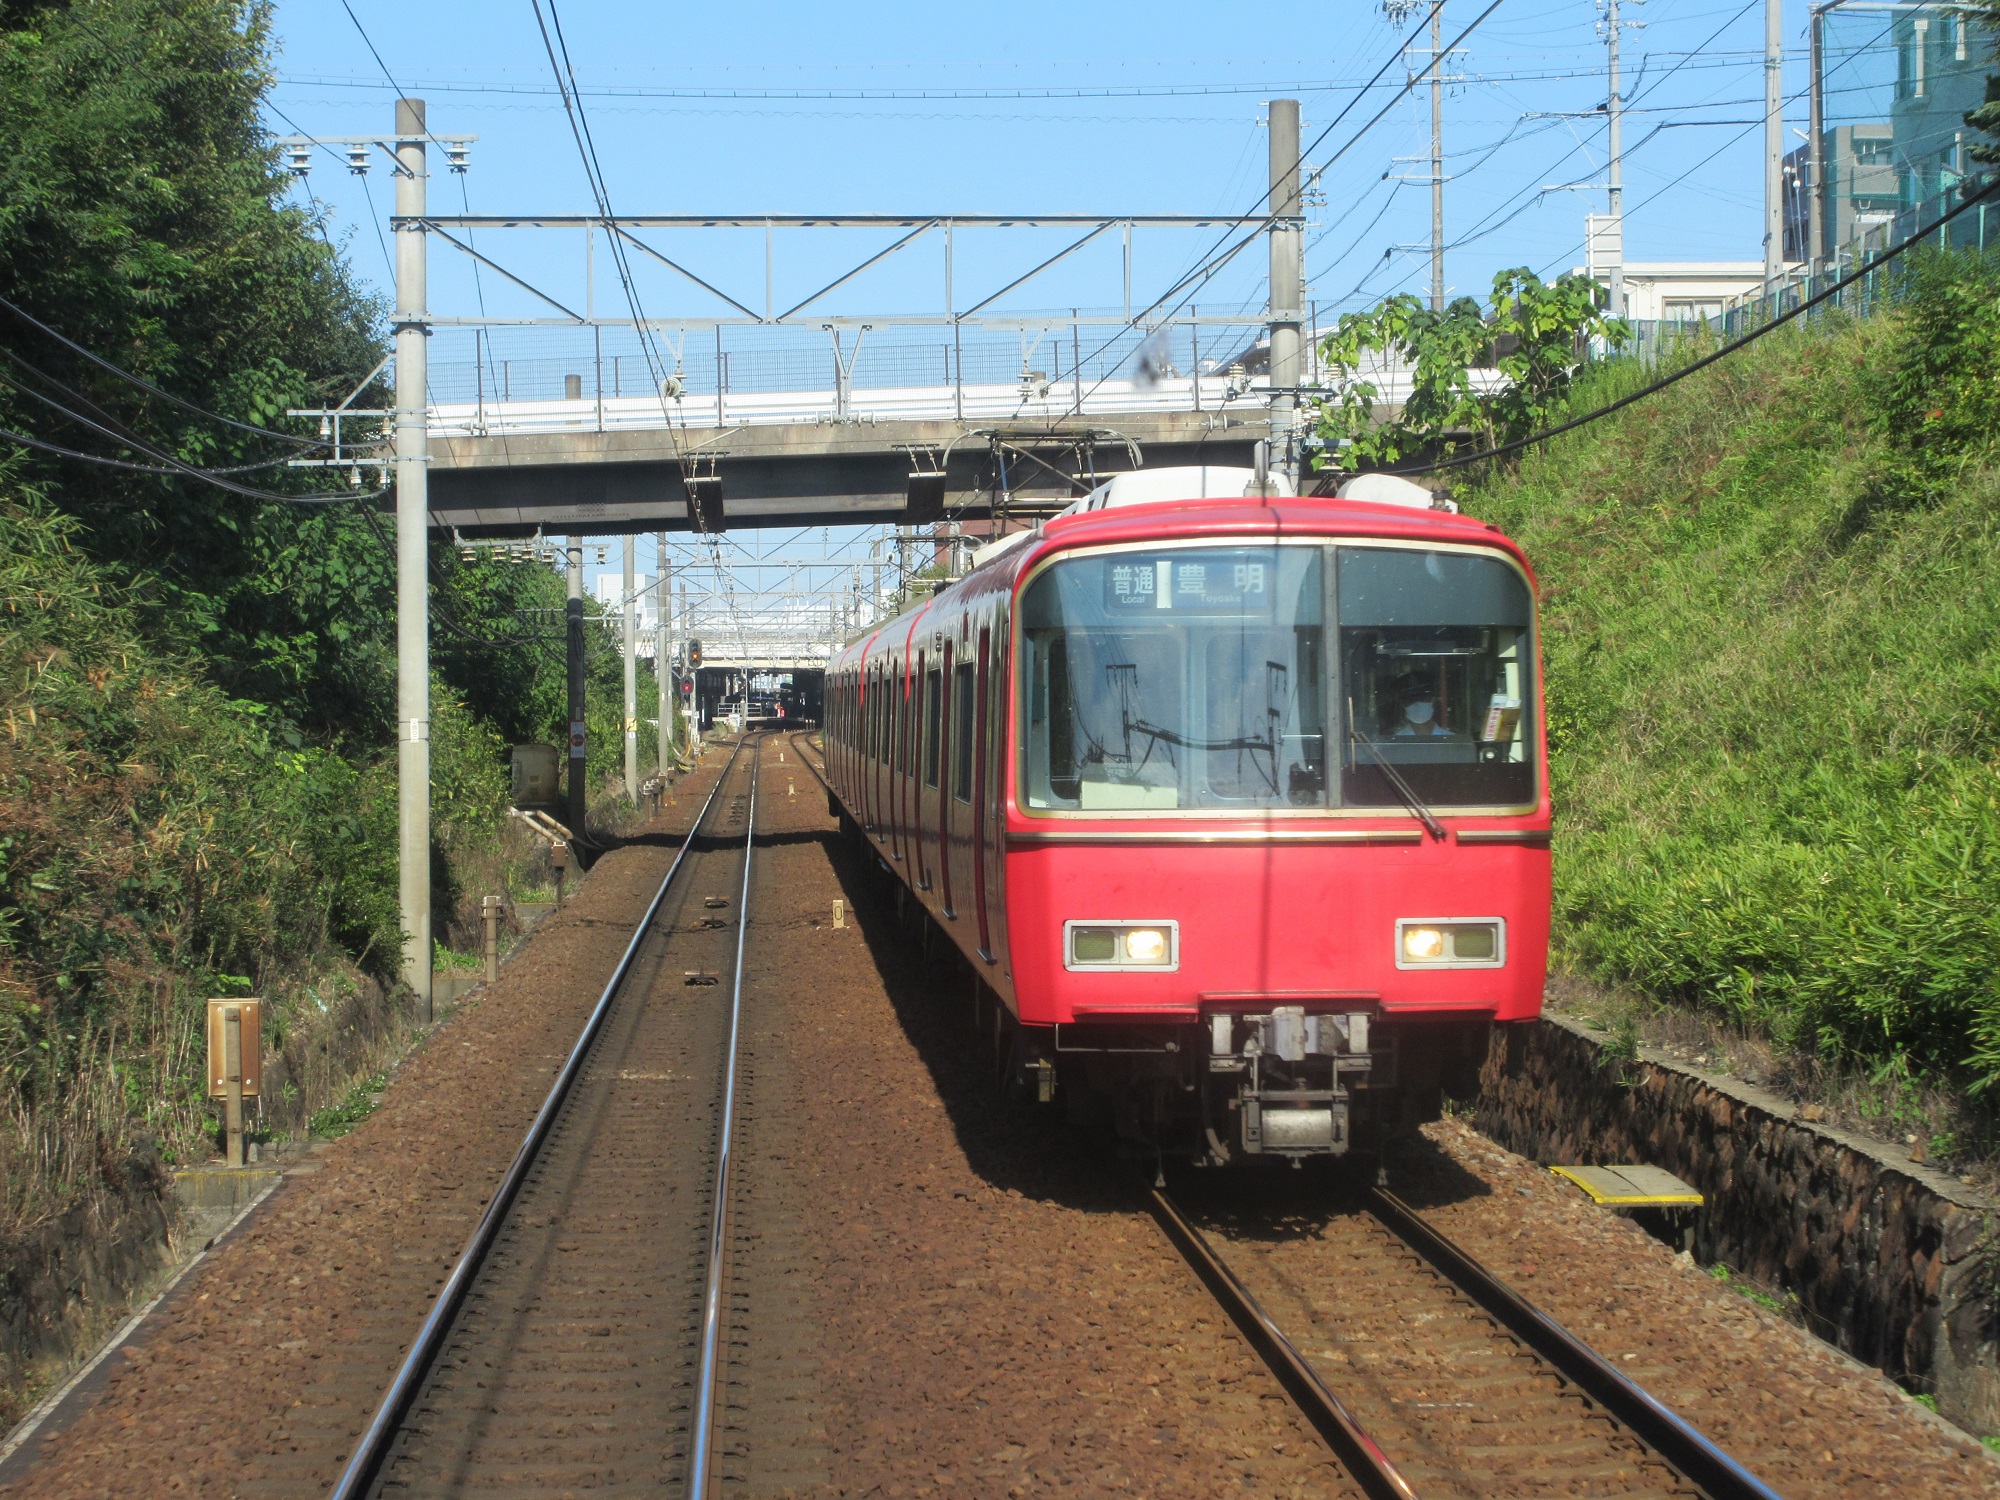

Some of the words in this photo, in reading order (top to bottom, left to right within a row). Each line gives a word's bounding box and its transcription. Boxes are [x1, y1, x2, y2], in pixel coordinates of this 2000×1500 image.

[1113, 566, 1153, 594] 普通
[1178, 564, 1263, 593] 豊明
[1121, 595, 1146, 604] Local
[1200, 594, 1241, 603] Toyoake
